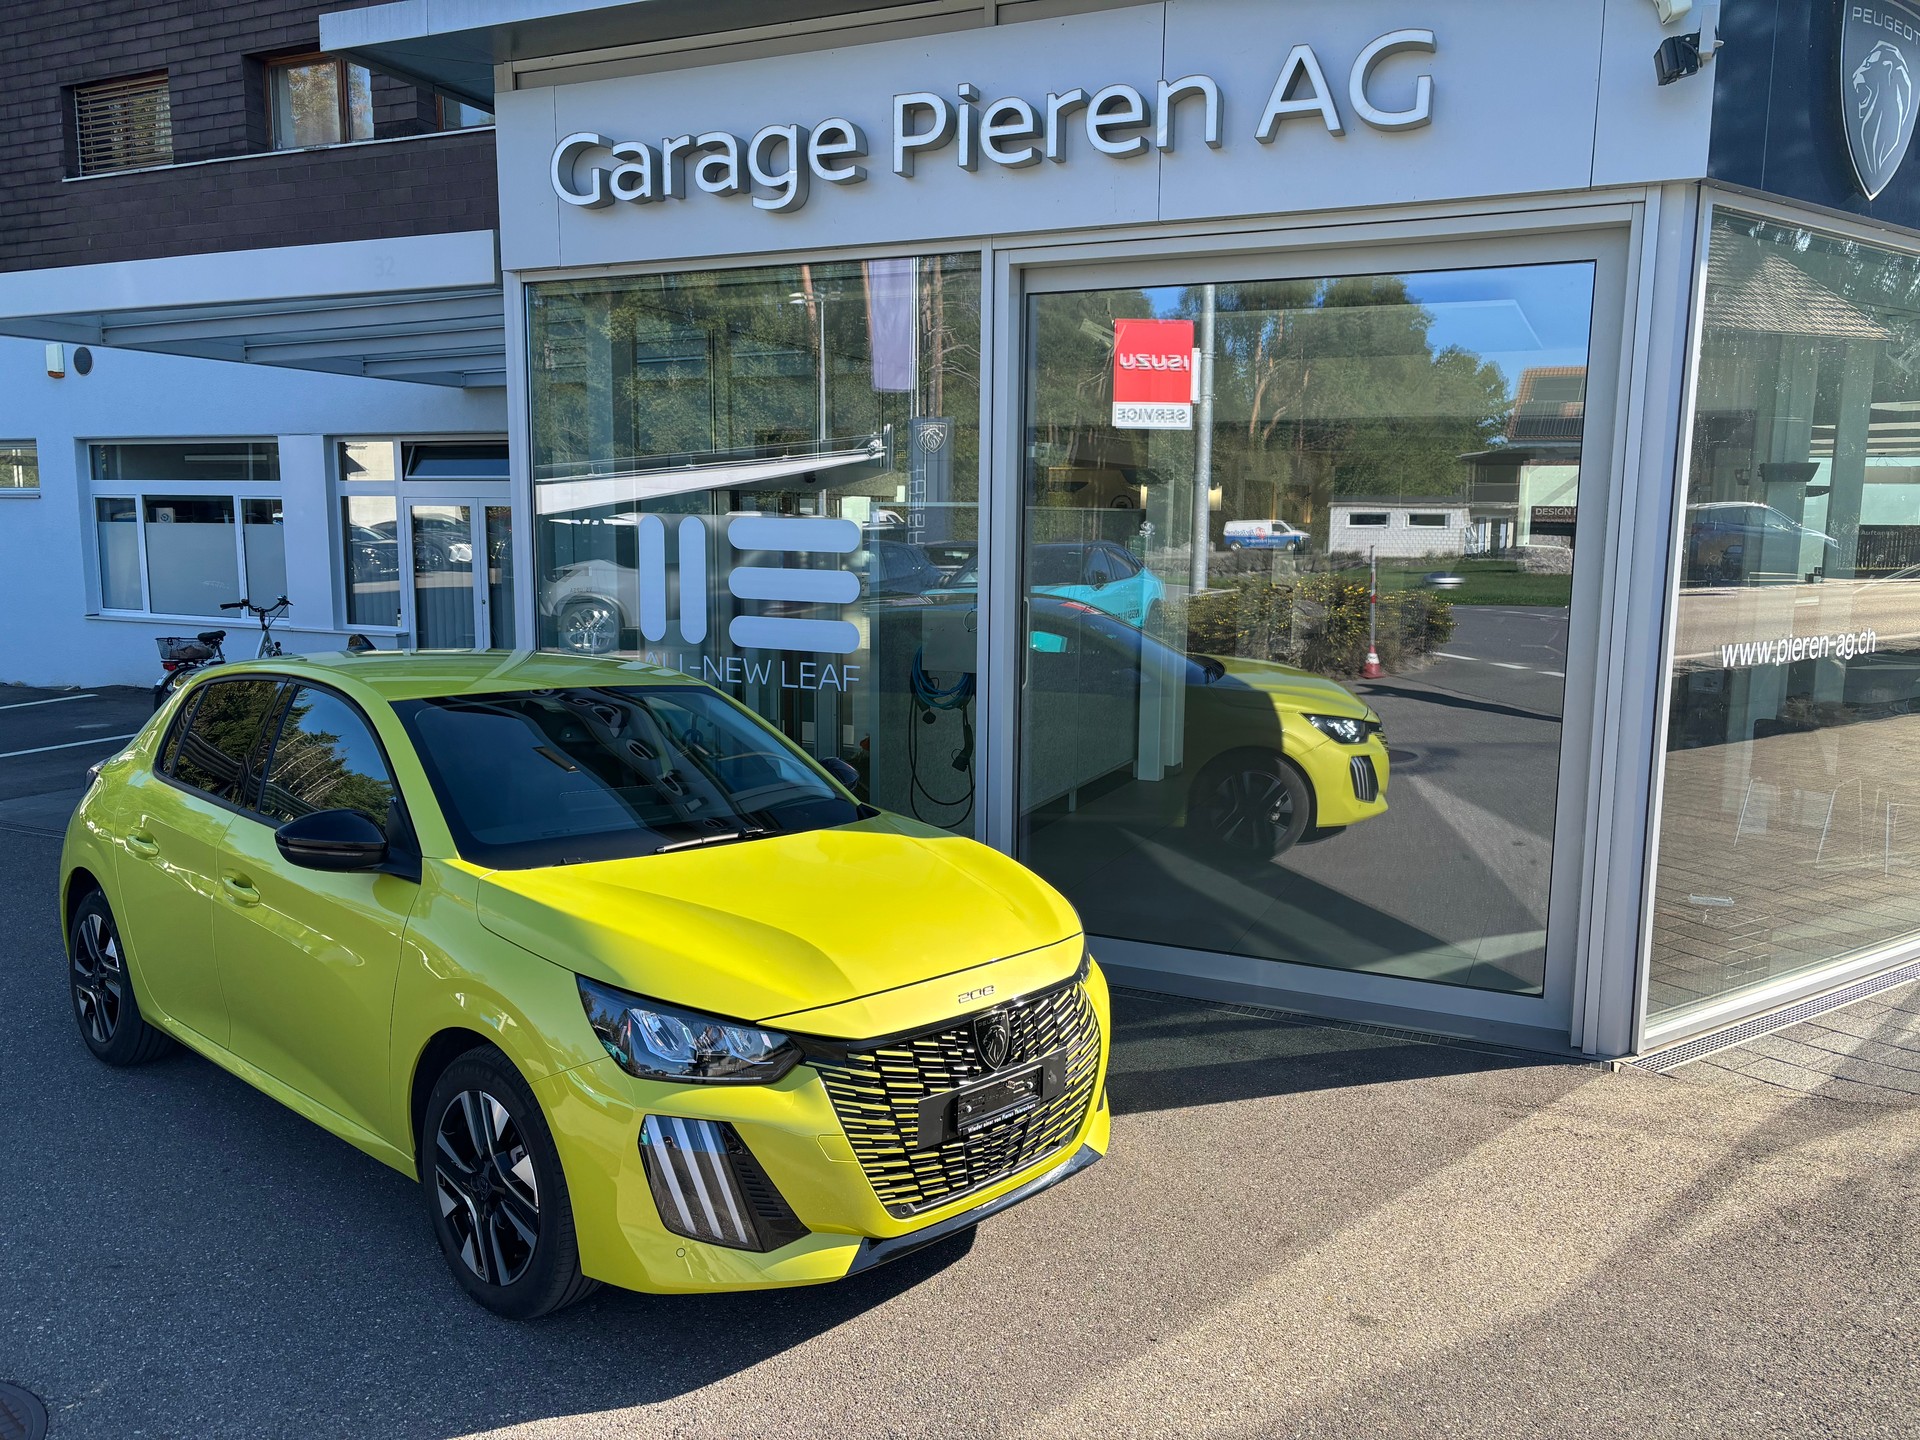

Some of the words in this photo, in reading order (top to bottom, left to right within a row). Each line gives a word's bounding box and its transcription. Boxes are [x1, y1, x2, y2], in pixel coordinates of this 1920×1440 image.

[1852, 6, 1920, 45] PEUGEOT
[550, 116, 868, 213] Garage
[893, 74, 1223, 177] Pieren
[1255, 28, 1436, 144] AG
[375, 255, 396, 277] 32
[1535, 507, 1572, 516] DESIGN
[1721, 627, 1876, 668] www.pieren-ag.ch
[781, 660, 861, 692] LEAF
[958, 985, 995, 1004] 208
